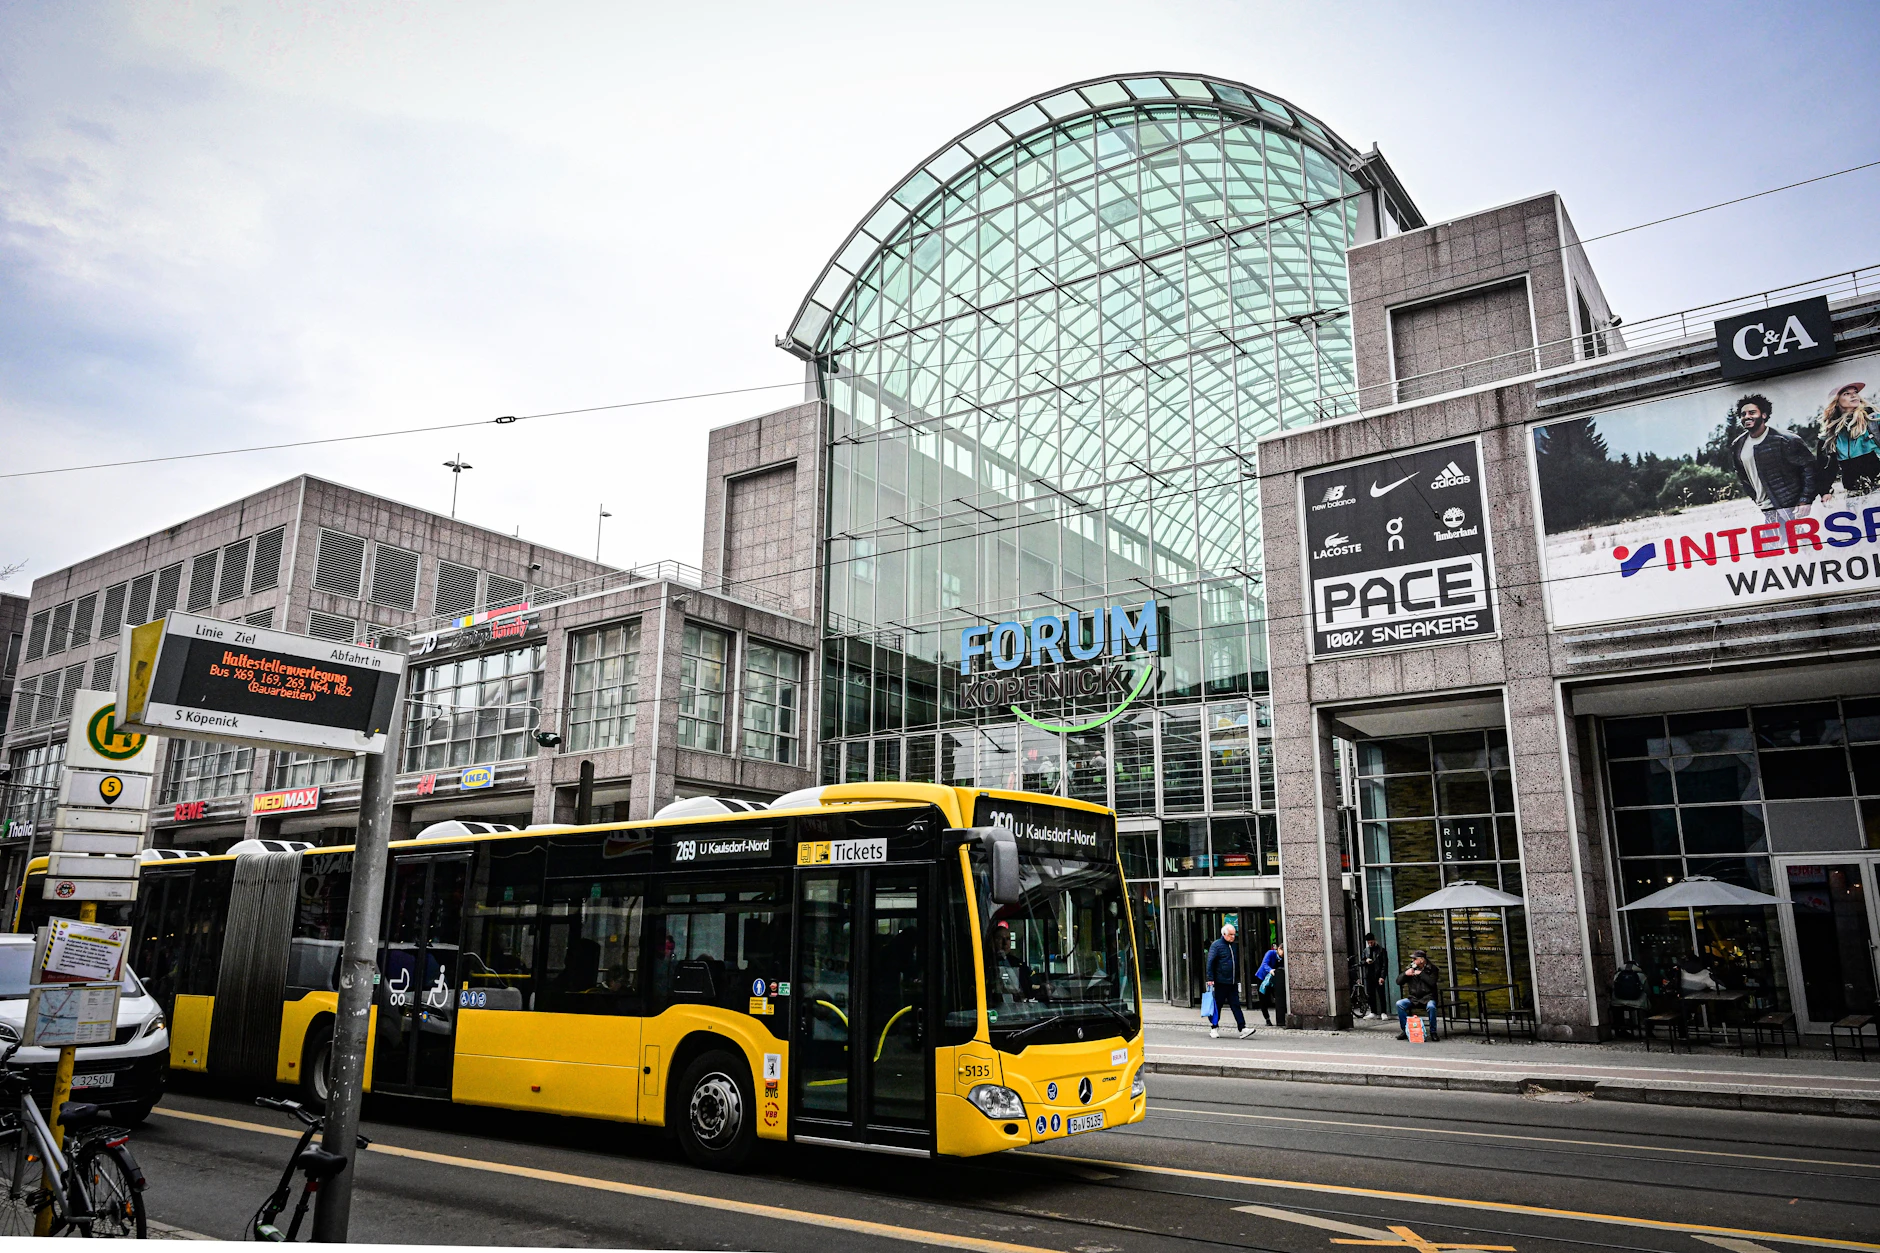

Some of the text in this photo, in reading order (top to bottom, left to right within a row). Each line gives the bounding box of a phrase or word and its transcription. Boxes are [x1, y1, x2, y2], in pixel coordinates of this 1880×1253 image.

[1732, 314, 1819, 362] C&A
[1430, 474, 1471, 490] adidas
[1312, 497, 1357, 512] new balance
[1434, 525, 1478, 542] Timberland
[1313, 543, 1362, 560] LACOSTE
[1323, 562, 1476, 624] PACE
[492, 616, 529, 639] family
[1326, 614, 1479, 648] 100% SNEAKERS
[195, 624, 381, 667] Linie Ziel Abfahrt in
[960, 600, 1158, 676] FORUM
[222, 651, 348, 685] Haltestellenverlegung
[209, 664, 353, 697] Bus X69, 169, 269, N64, N62
[960, 664, 1125, 709] KÖPENICK
[248, 682, 317, 702] (Bauarbeiten)
[175, 710, 240, 728] S Köpenick
[107, 782, 116, 793] 5
[465, 772, 488, 783] IKEA
[253, 789, 317, 811] MEDIMAX
[174, 801, 206, 822] REWE
[8, 820, 33, 838] Thalia
[1015, 822, 1024, 838] U
[1026, 823, 1096, 847] Kaulsdorf-Nord
[676, 839, 770, 861] 269 U Kaulsdorf-Nord
[834, 843, 883, 861] Tickets
[965, 1065, 990, 1077] 5135
[765, 1087, 779, 1099] BVG
[765, 1110, 778, 1118] VBB
